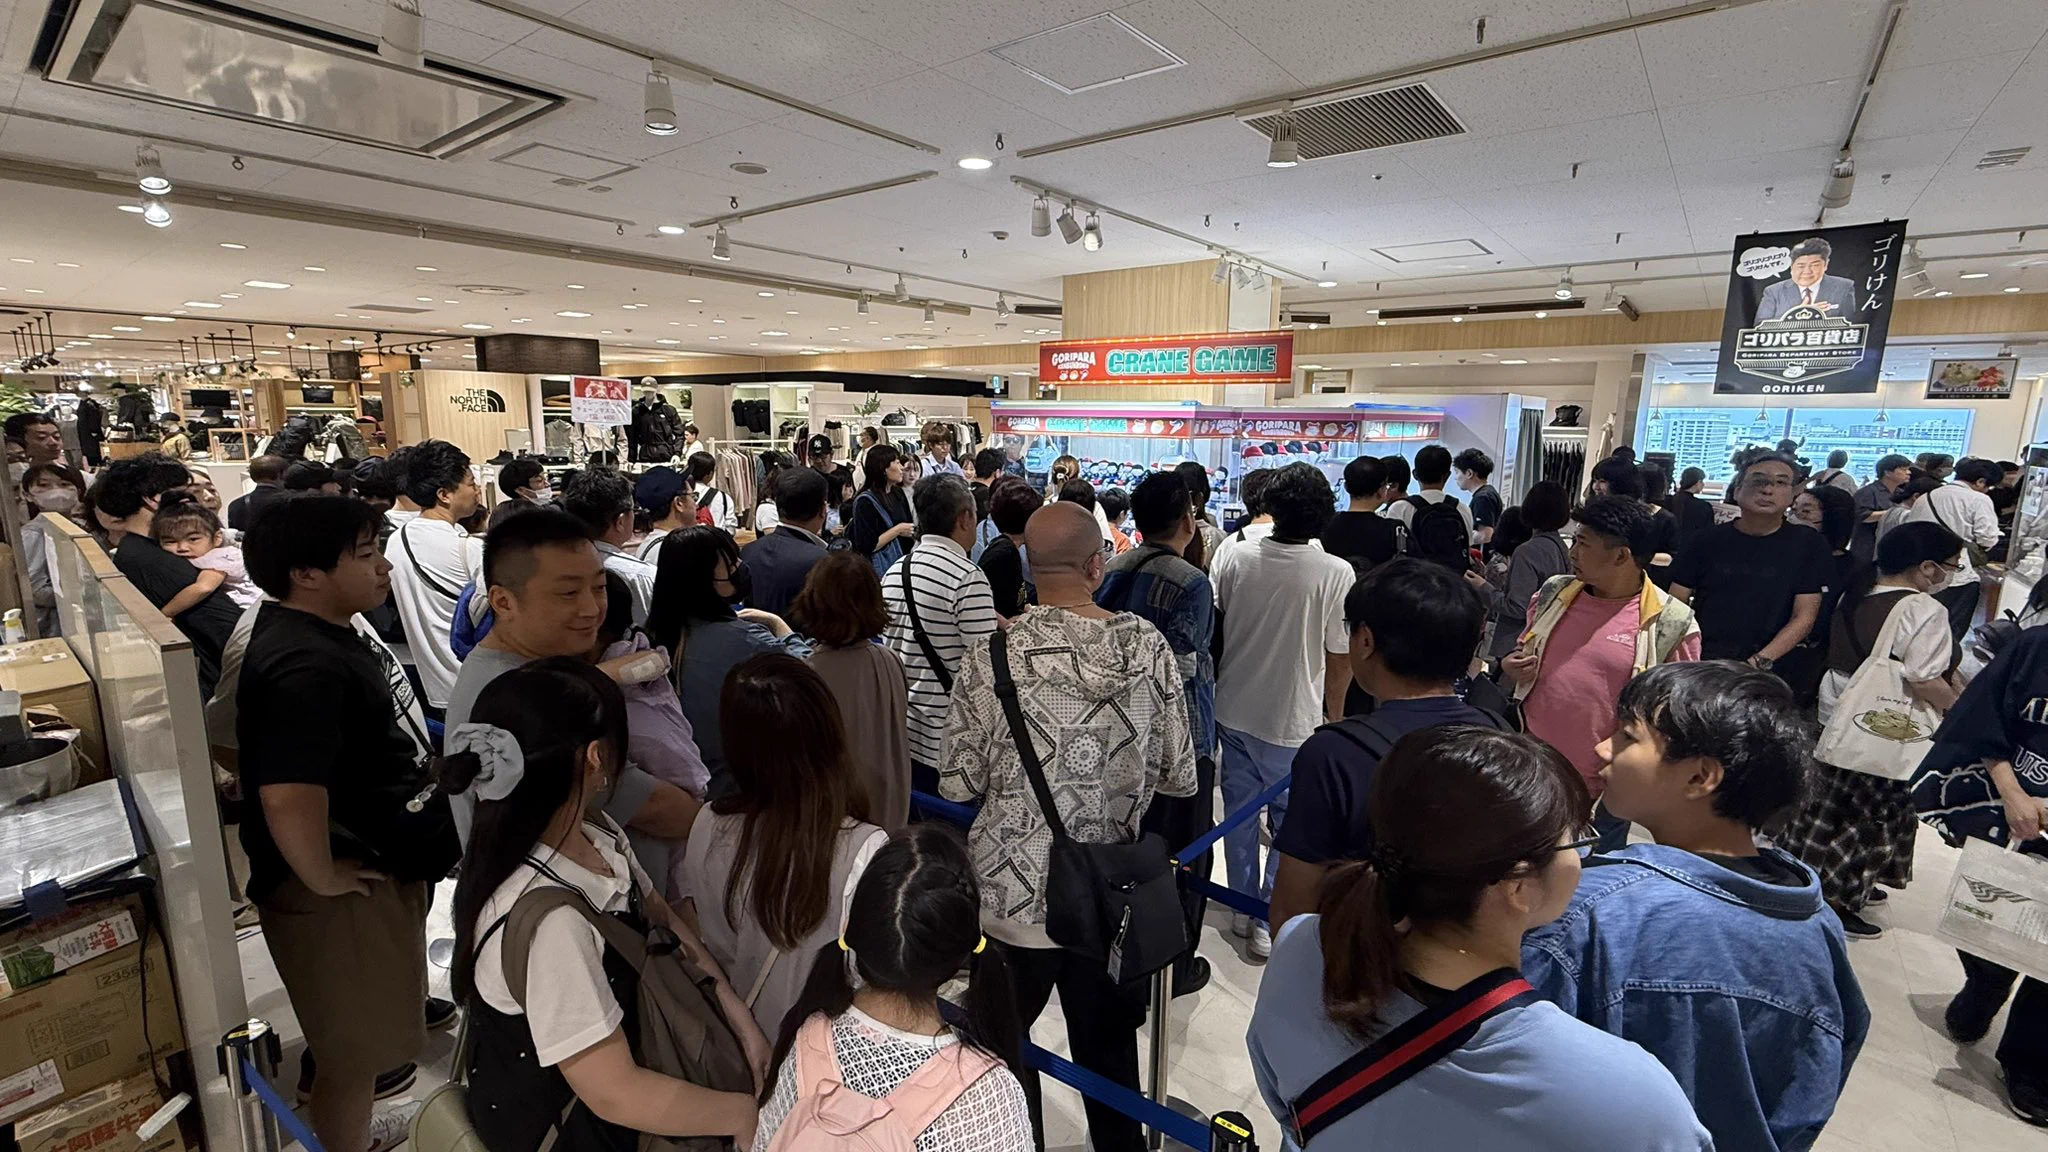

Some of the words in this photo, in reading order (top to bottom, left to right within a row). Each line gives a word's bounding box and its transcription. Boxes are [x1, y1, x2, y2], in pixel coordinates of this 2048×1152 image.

[1861, 233, 1898, 312] ゴリけん
[1743, 329, 1860, 347] ゴリパラ百貨店
[1052, 351, 1096, 367] GORIPARA
[1106, 348, 1190, 376] CRANE
[1194, 344, 1278, 375] GAME
[465, 388, 486, 397] THE
[1762, 384, 1825, 393] GORIKEN
[450, 395, 487, 405] NORTH
[462, 403, 487, 412] FACE
[1255, 420, 1301, 433] GORIPARA
